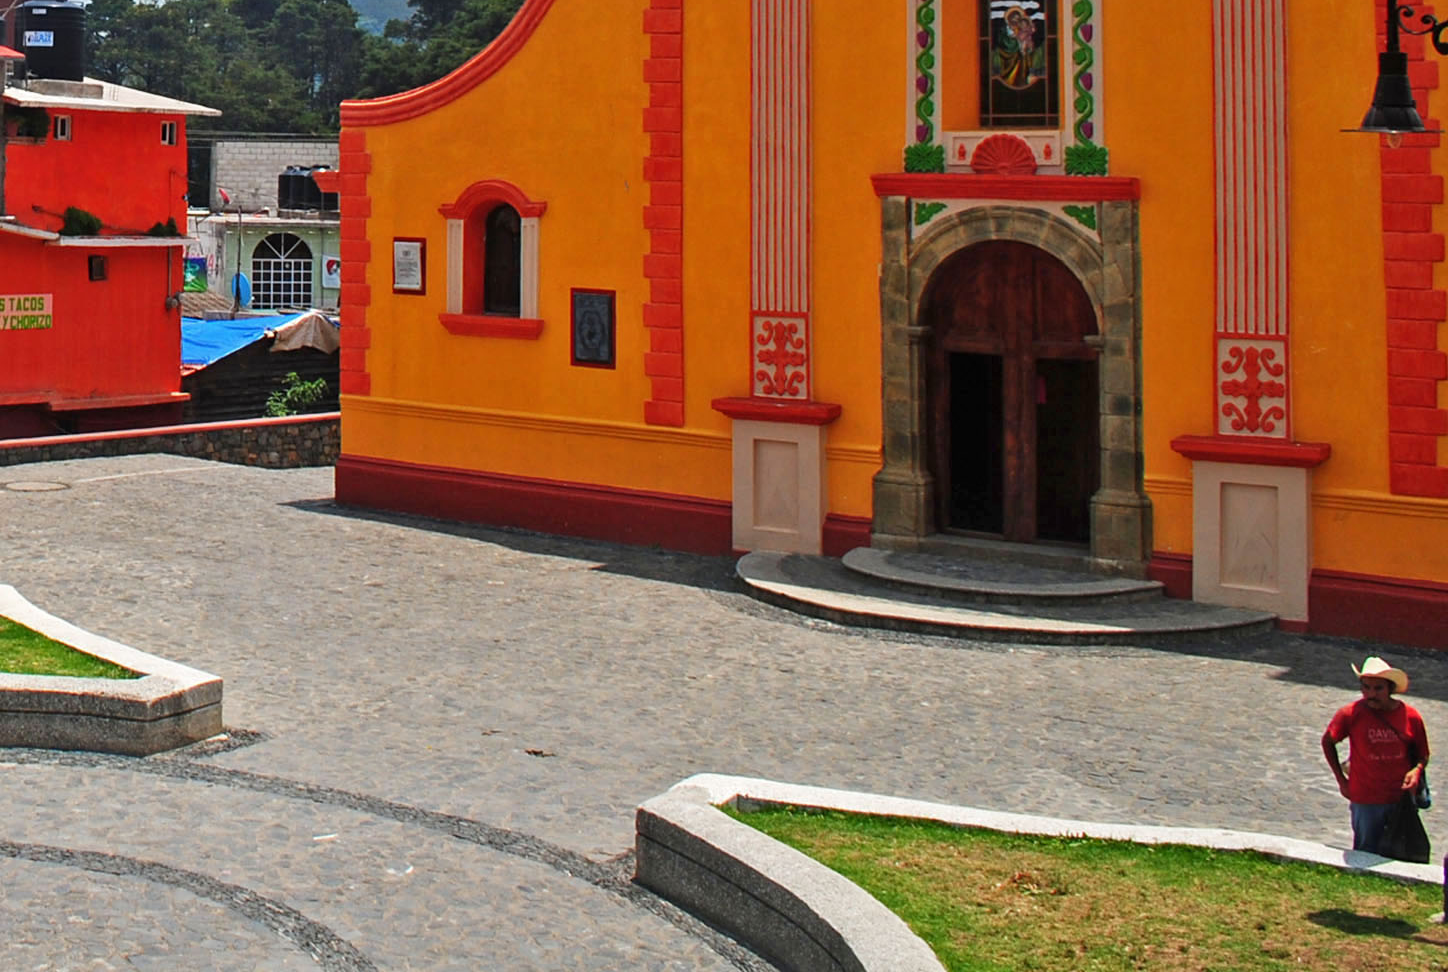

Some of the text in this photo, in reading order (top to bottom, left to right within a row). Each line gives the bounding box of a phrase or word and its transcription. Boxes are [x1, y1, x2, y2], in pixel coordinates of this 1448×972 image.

[9, 296, 45, 311] TACOS
[2, 315, 9, 330] Y
[10, 314, 52, 329] CHORIZO
